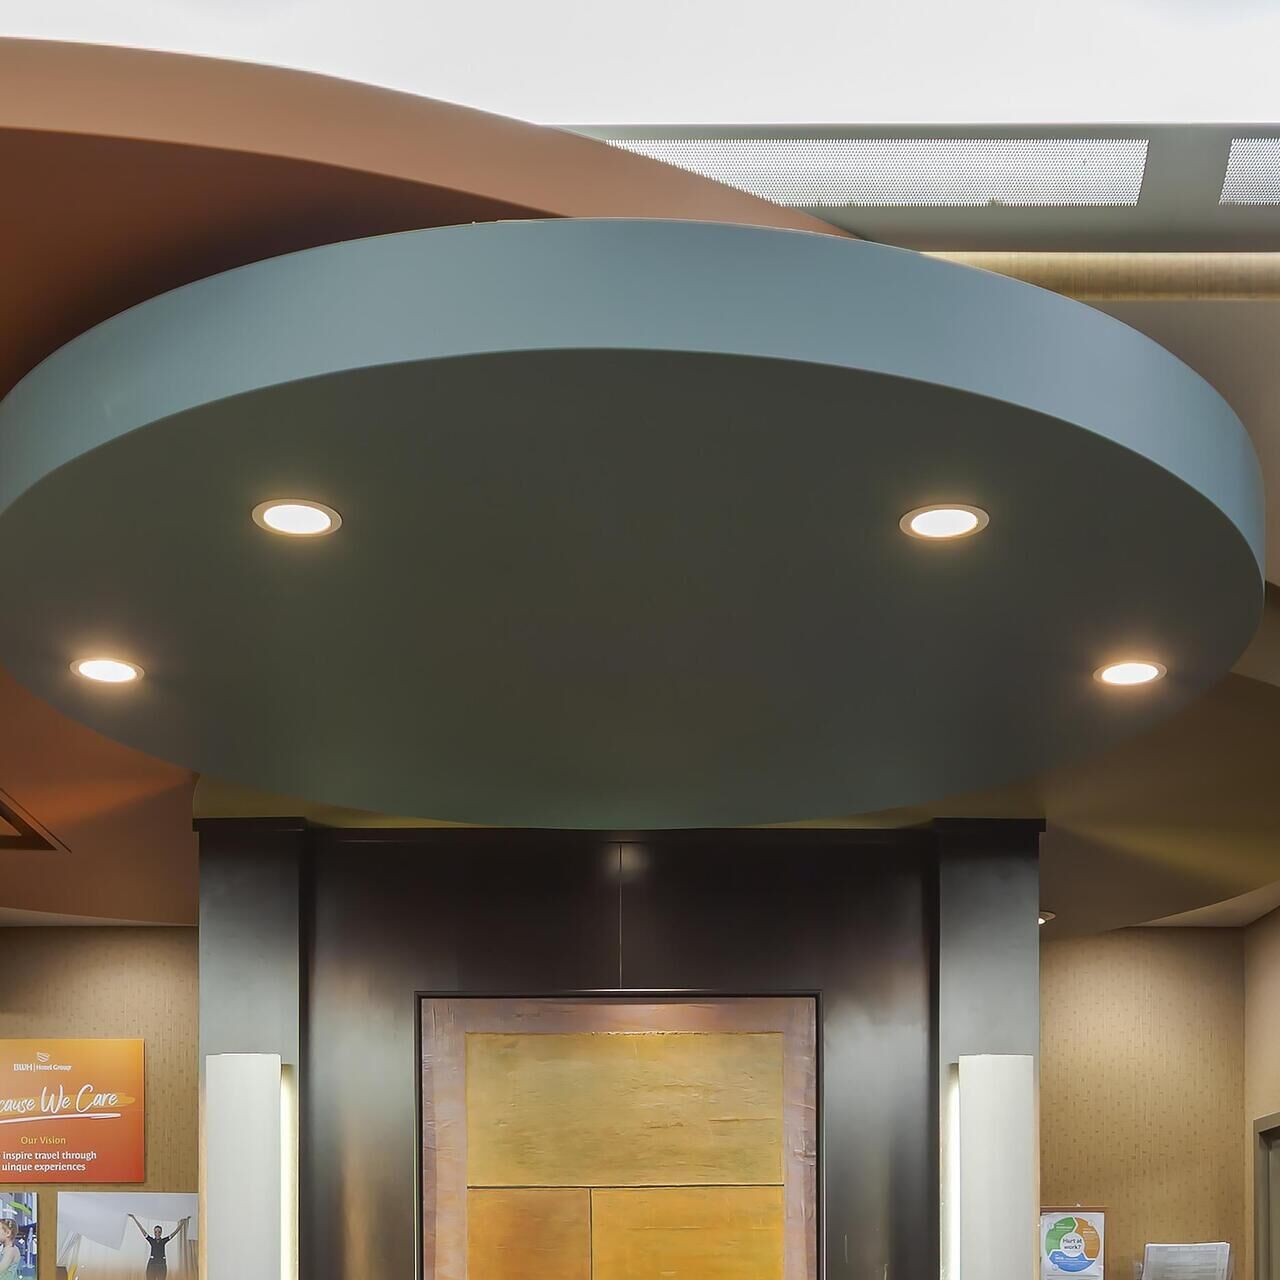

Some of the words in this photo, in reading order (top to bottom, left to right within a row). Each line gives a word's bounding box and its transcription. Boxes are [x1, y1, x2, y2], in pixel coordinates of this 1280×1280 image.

[41, 1085, 71, 1114] We
[76, 1084, 119, 1113] Care
[20, 1136, 37, 1145] Our
[40, 1136, 67, 1145] Vision
[3, 1151, 33, 1162] inspire
[34, 1151, 59, 1160] travel
[62, 1151, 97, 1162] through
[34, 1163, 86, 1173] experiences
